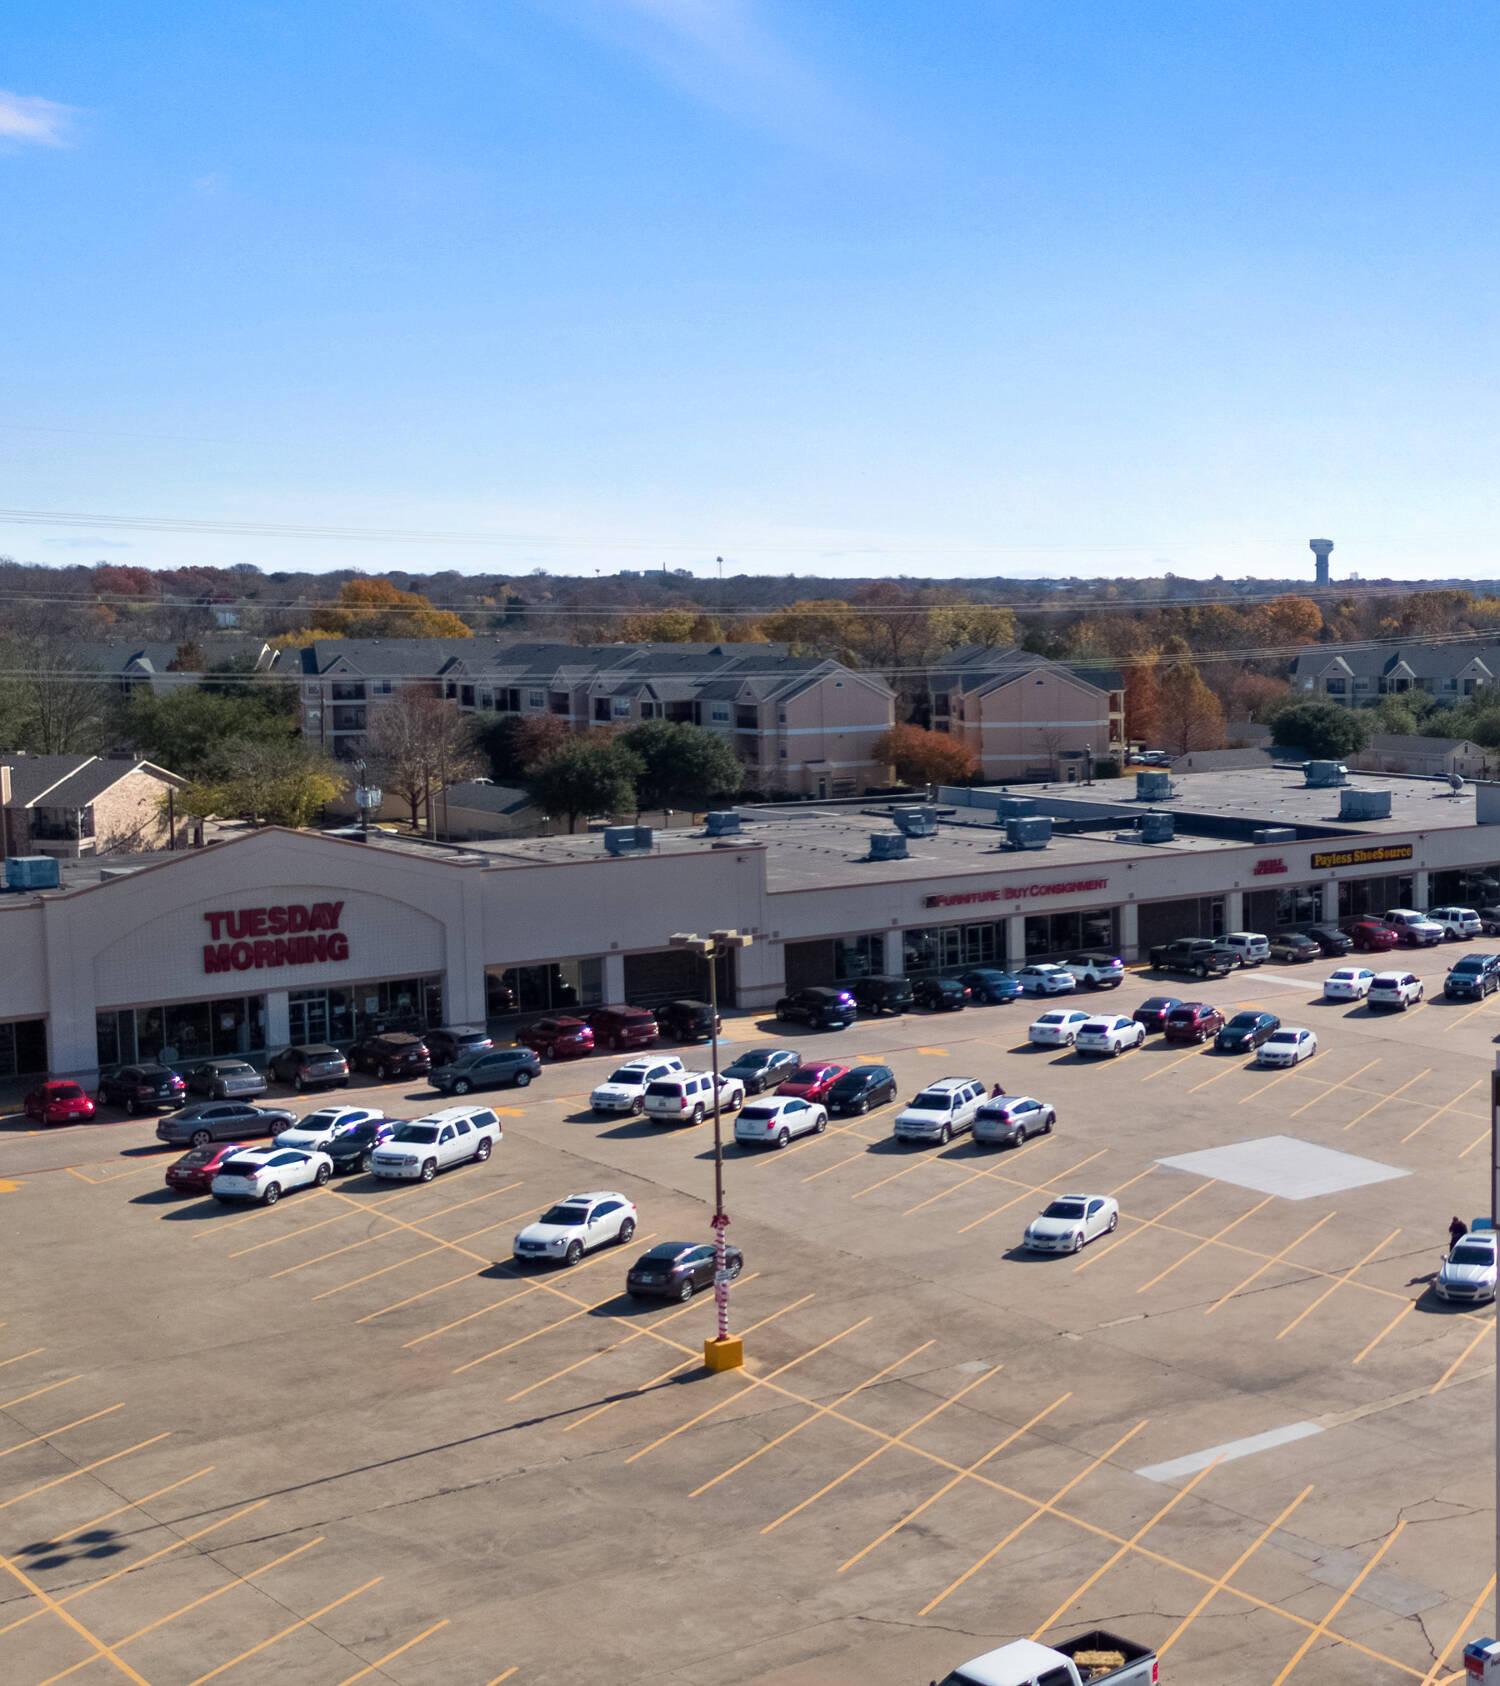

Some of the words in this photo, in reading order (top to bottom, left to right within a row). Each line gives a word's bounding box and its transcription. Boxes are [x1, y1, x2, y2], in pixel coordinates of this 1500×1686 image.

[1314, 853, 1353, 868] Payless
[1353, 846, 1412, 862] ShoeSource
[935, 889, 1000, 907] FURNITURE
[1003, 887, 1030, 899] BUY
[1029, 878, 1109, 896] CONSIGNMENT
[204, 901, 345, 941] TUESDAY
[203, 932, 349, 974] MORNING
